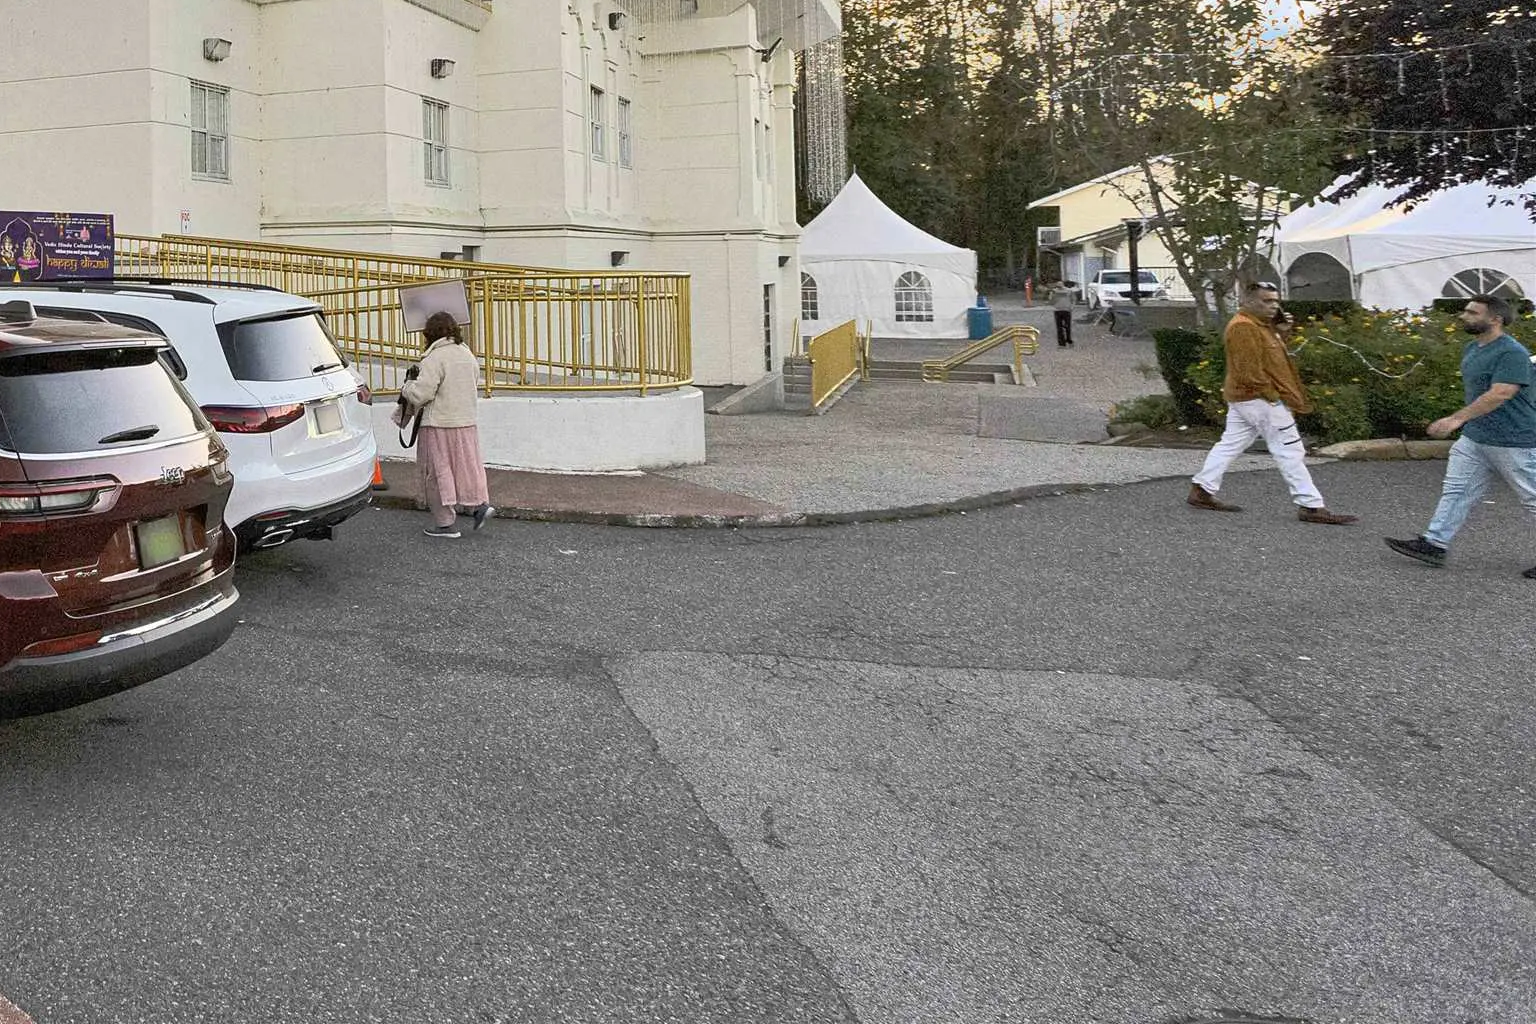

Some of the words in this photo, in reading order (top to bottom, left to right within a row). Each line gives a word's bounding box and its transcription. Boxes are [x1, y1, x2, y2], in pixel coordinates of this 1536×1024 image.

[94, 243, 111, 251] Society
[46, 254, 77, 271] happy
[80, 255, 109, 269] diwali
[159, 465, 184, 484] Jeep
